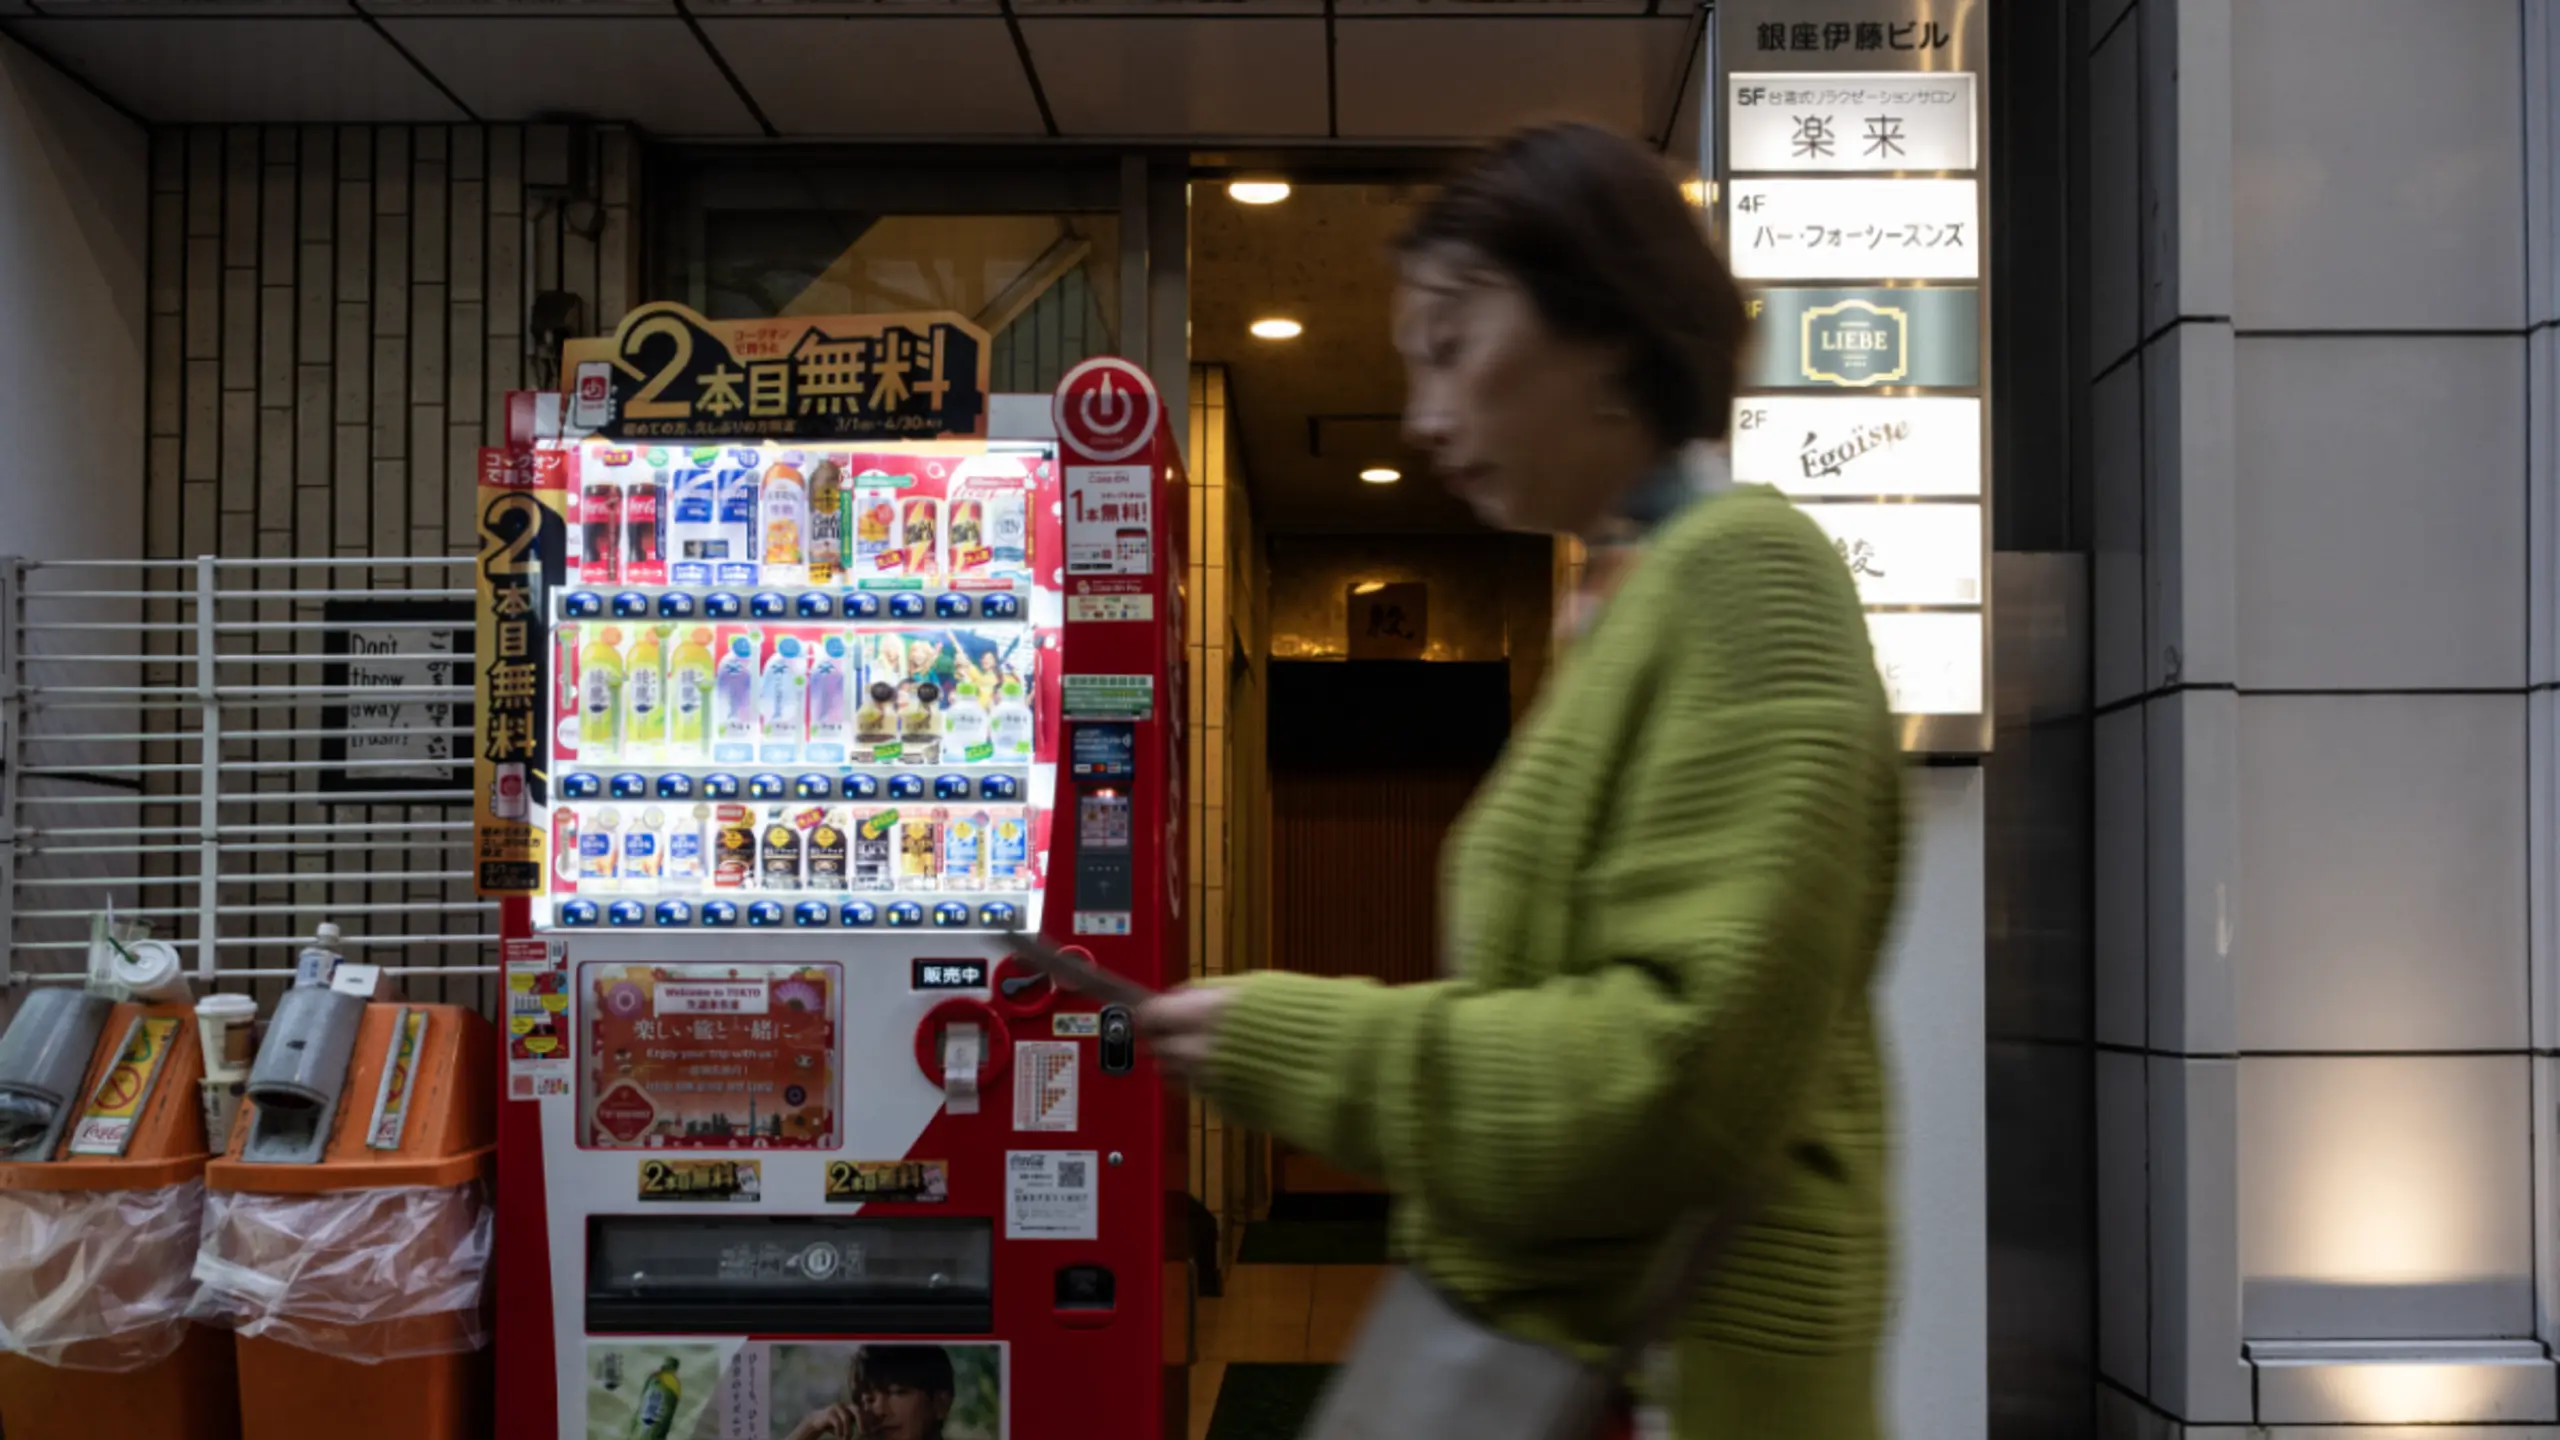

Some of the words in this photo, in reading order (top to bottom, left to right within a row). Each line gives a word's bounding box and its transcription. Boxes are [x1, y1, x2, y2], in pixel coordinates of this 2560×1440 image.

[1757, 22, 1950, 51] 銀座伊藤ビル
[1737, 88, 1766, 106] 5F
[1737, 194, 1767, 213] 4F
[1821, 331, 1888, 350] LIEBE
[1740, 409, 1767, 429] 2F
[923, 966, 980, 984] 販売中
